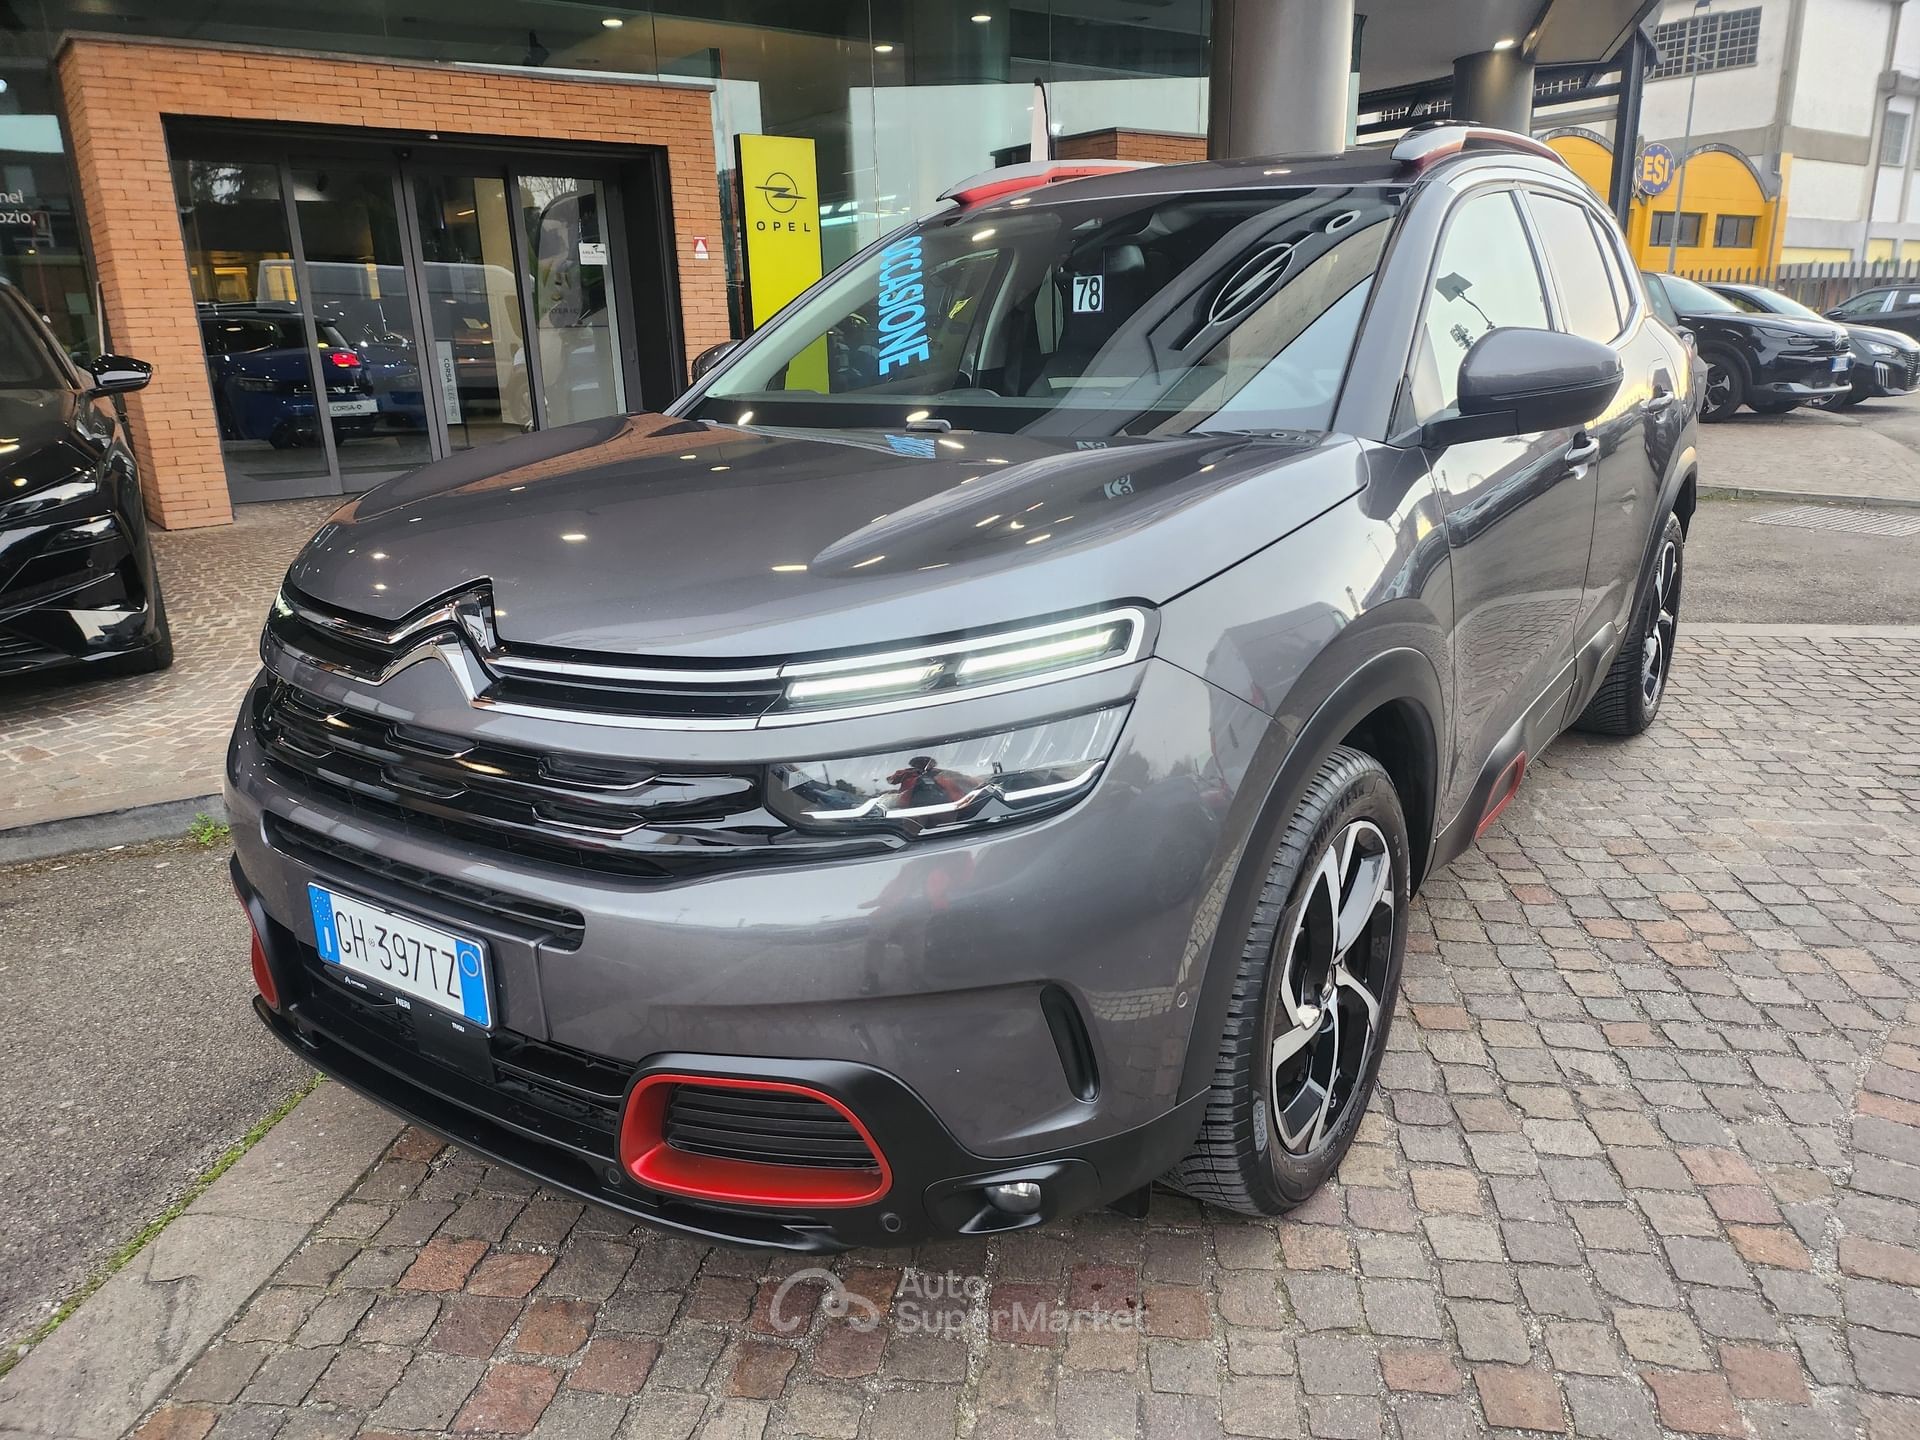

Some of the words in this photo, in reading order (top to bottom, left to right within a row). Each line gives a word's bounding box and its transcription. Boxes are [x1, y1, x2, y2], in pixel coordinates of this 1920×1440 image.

[1642, 153, 1670, 185] ESI
[756, 221, 811, 232] OPEL
[878, 235, 930, 375] OCCASIONE
[1075, 277, 1101, 310] 78
